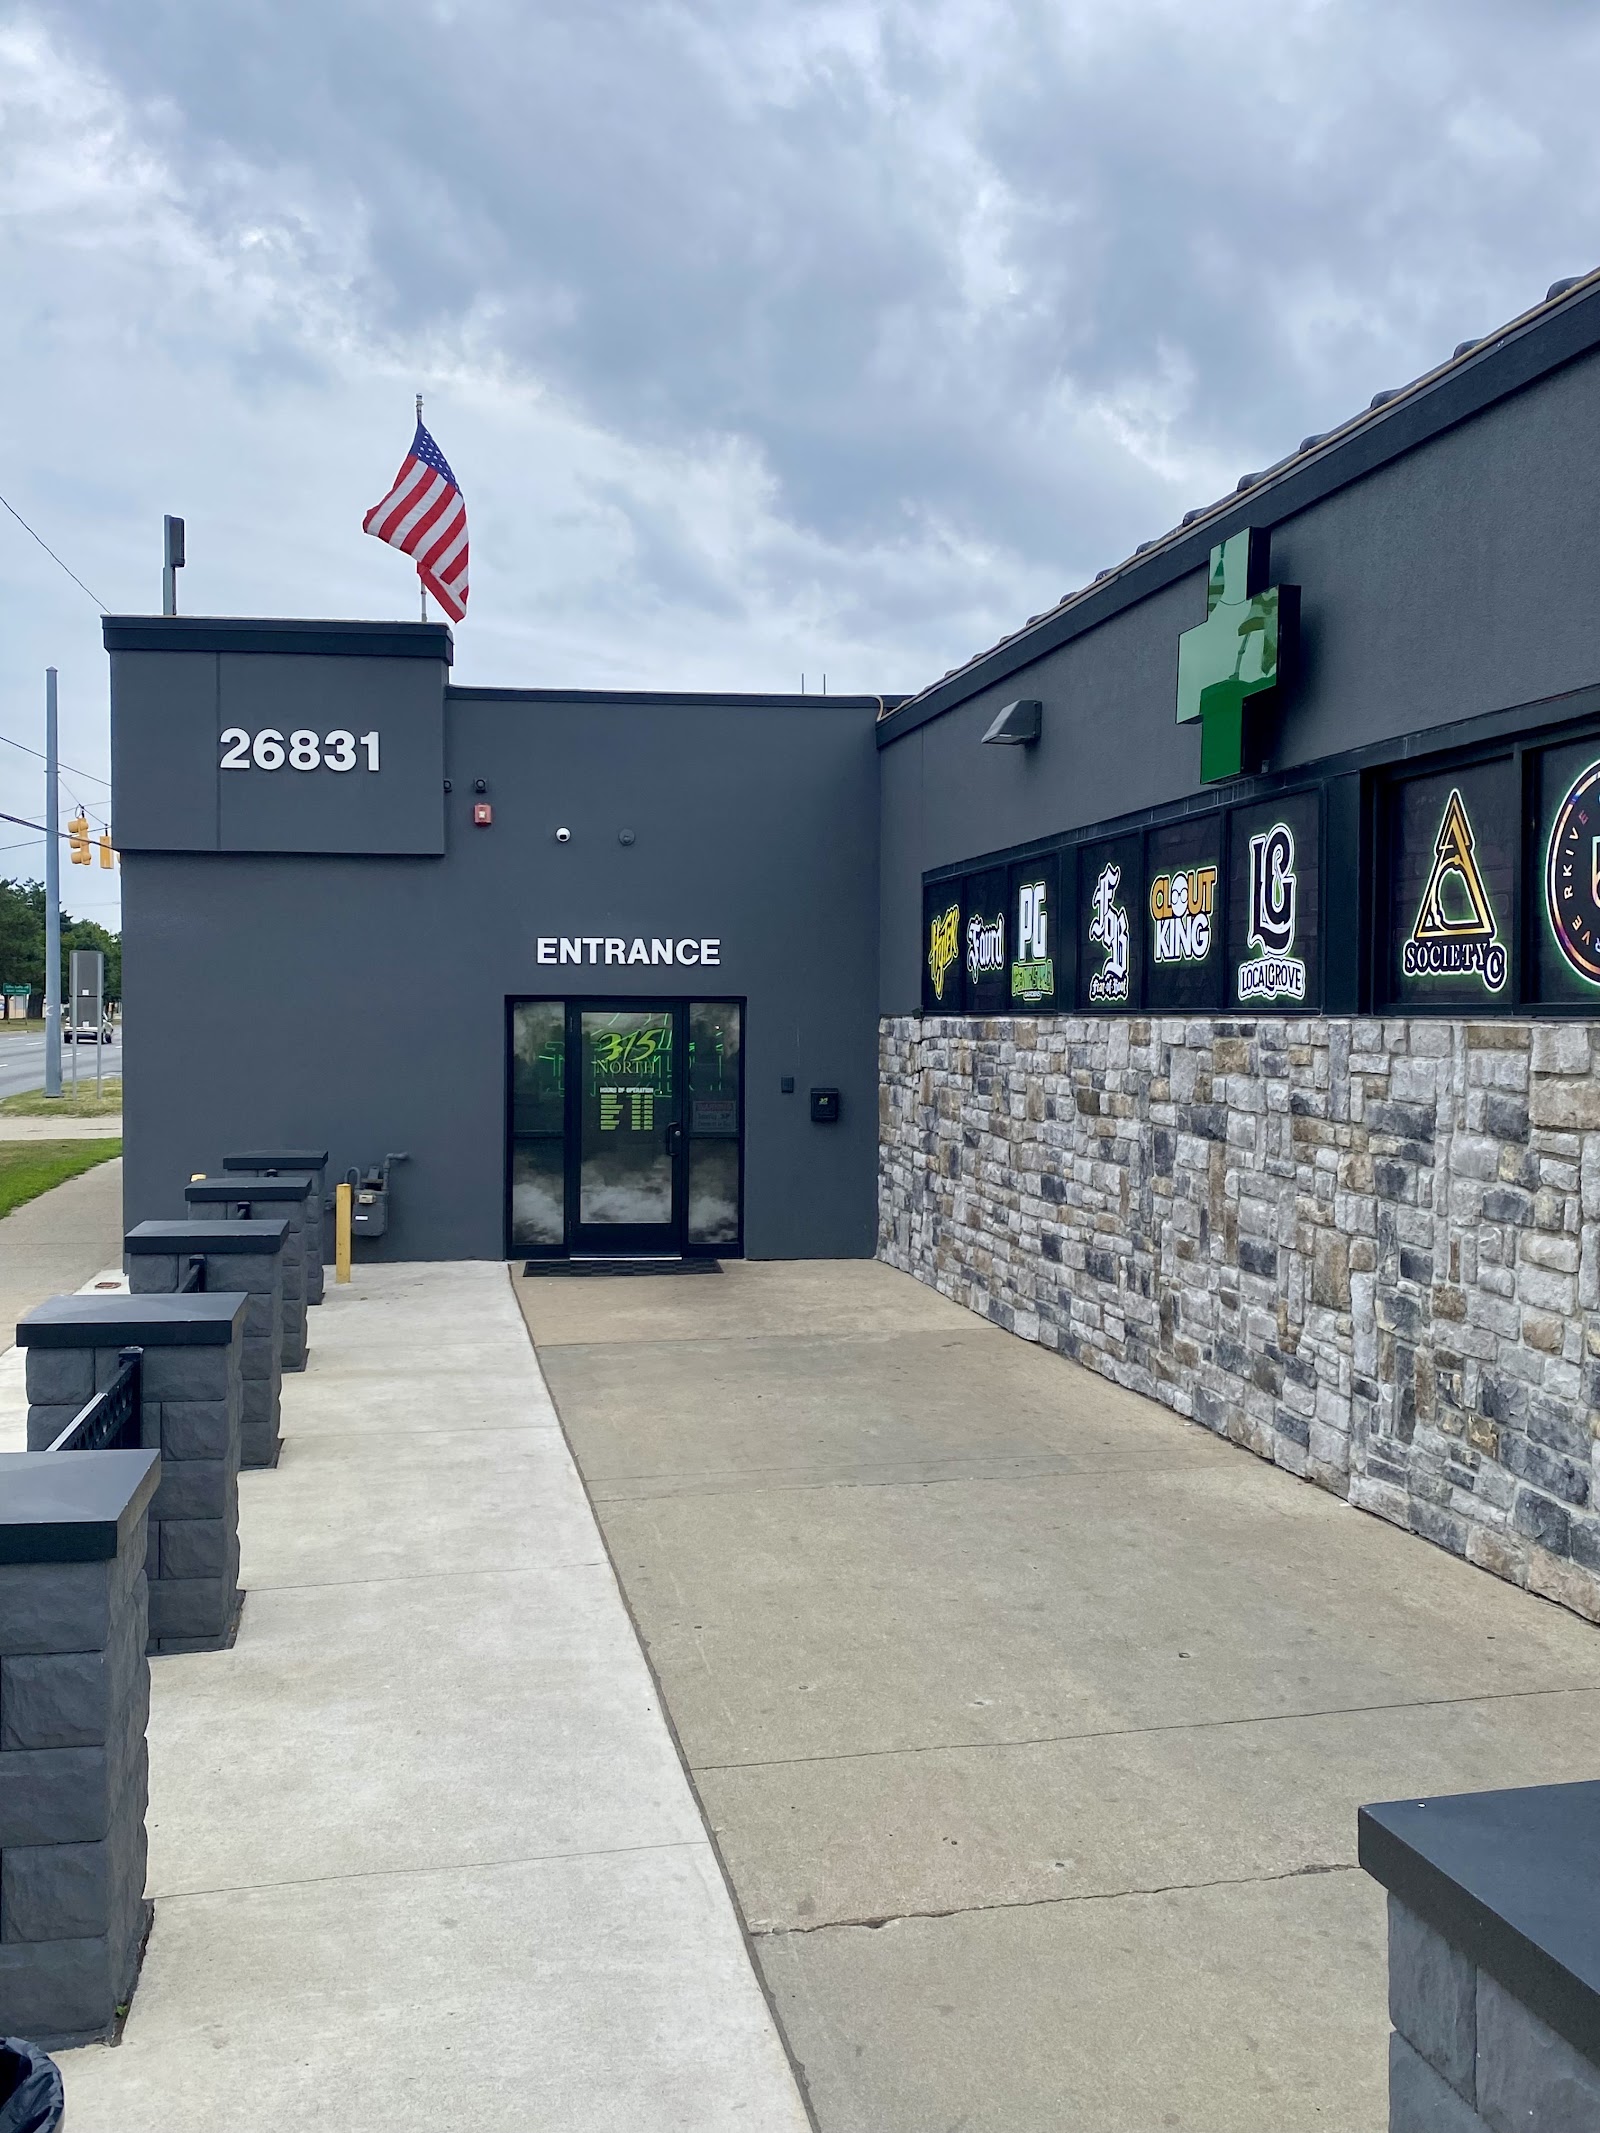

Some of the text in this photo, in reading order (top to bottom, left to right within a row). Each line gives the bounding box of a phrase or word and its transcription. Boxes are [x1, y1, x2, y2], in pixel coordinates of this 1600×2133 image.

[220, 727, 380, 772] 26831
[1151, 868, 1216, 919] CLOUT
[1019, 883, 1047, 961] PG
[1156, 913, 1210, 959] KING
[537, 937, 721, 965] ENTRANCE
[1405, 942, 1487, 969] SOCIETY
[599, 1028, 663, 1061] 315
[596, 1060, 656, 1074] NORTH
